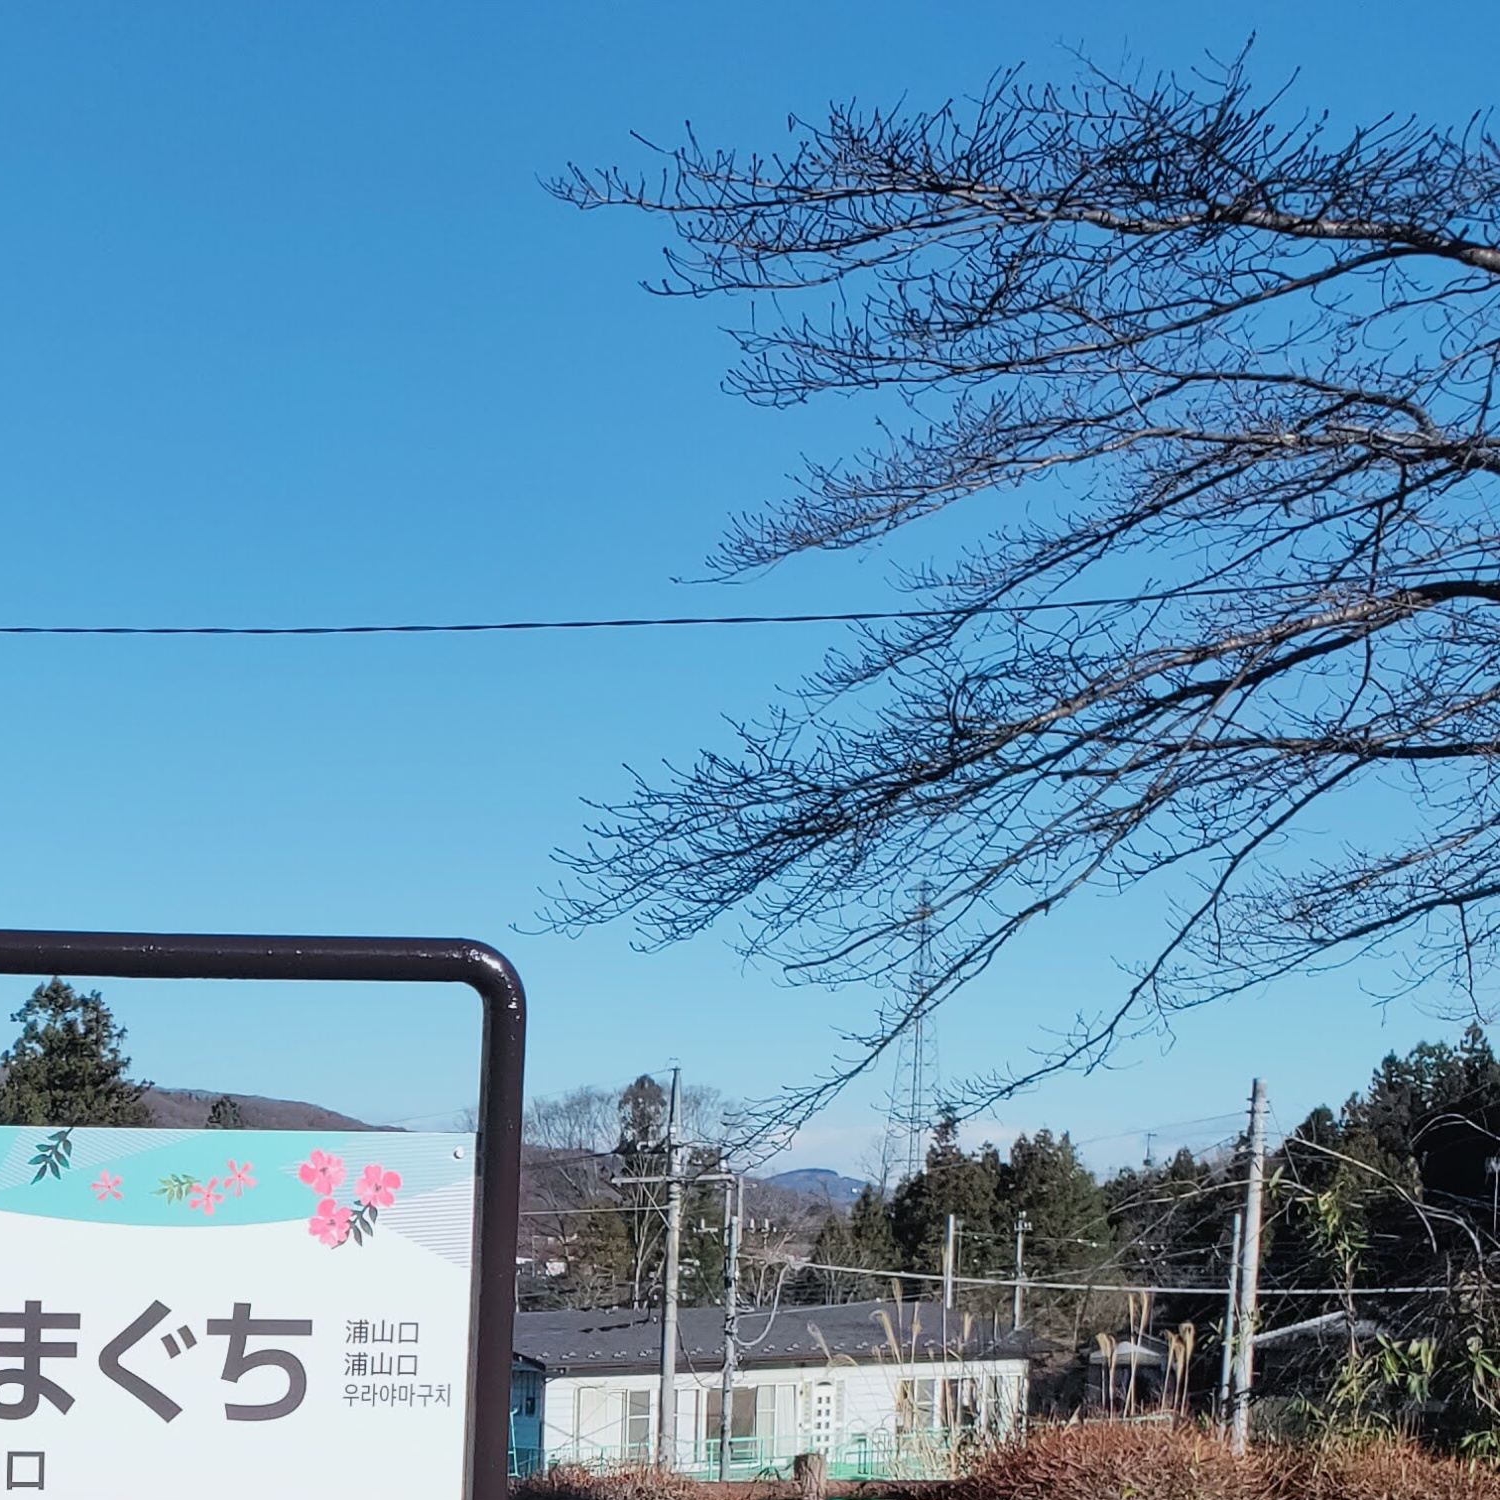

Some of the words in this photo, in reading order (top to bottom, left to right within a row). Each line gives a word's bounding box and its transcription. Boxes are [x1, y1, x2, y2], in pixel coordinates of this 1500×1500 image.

[345, 1319, 419, 1344] 浦山口
[344, 1351, 418, 1377] 浦山口
[342, 1383, 451, 1407] 우라야마구치
